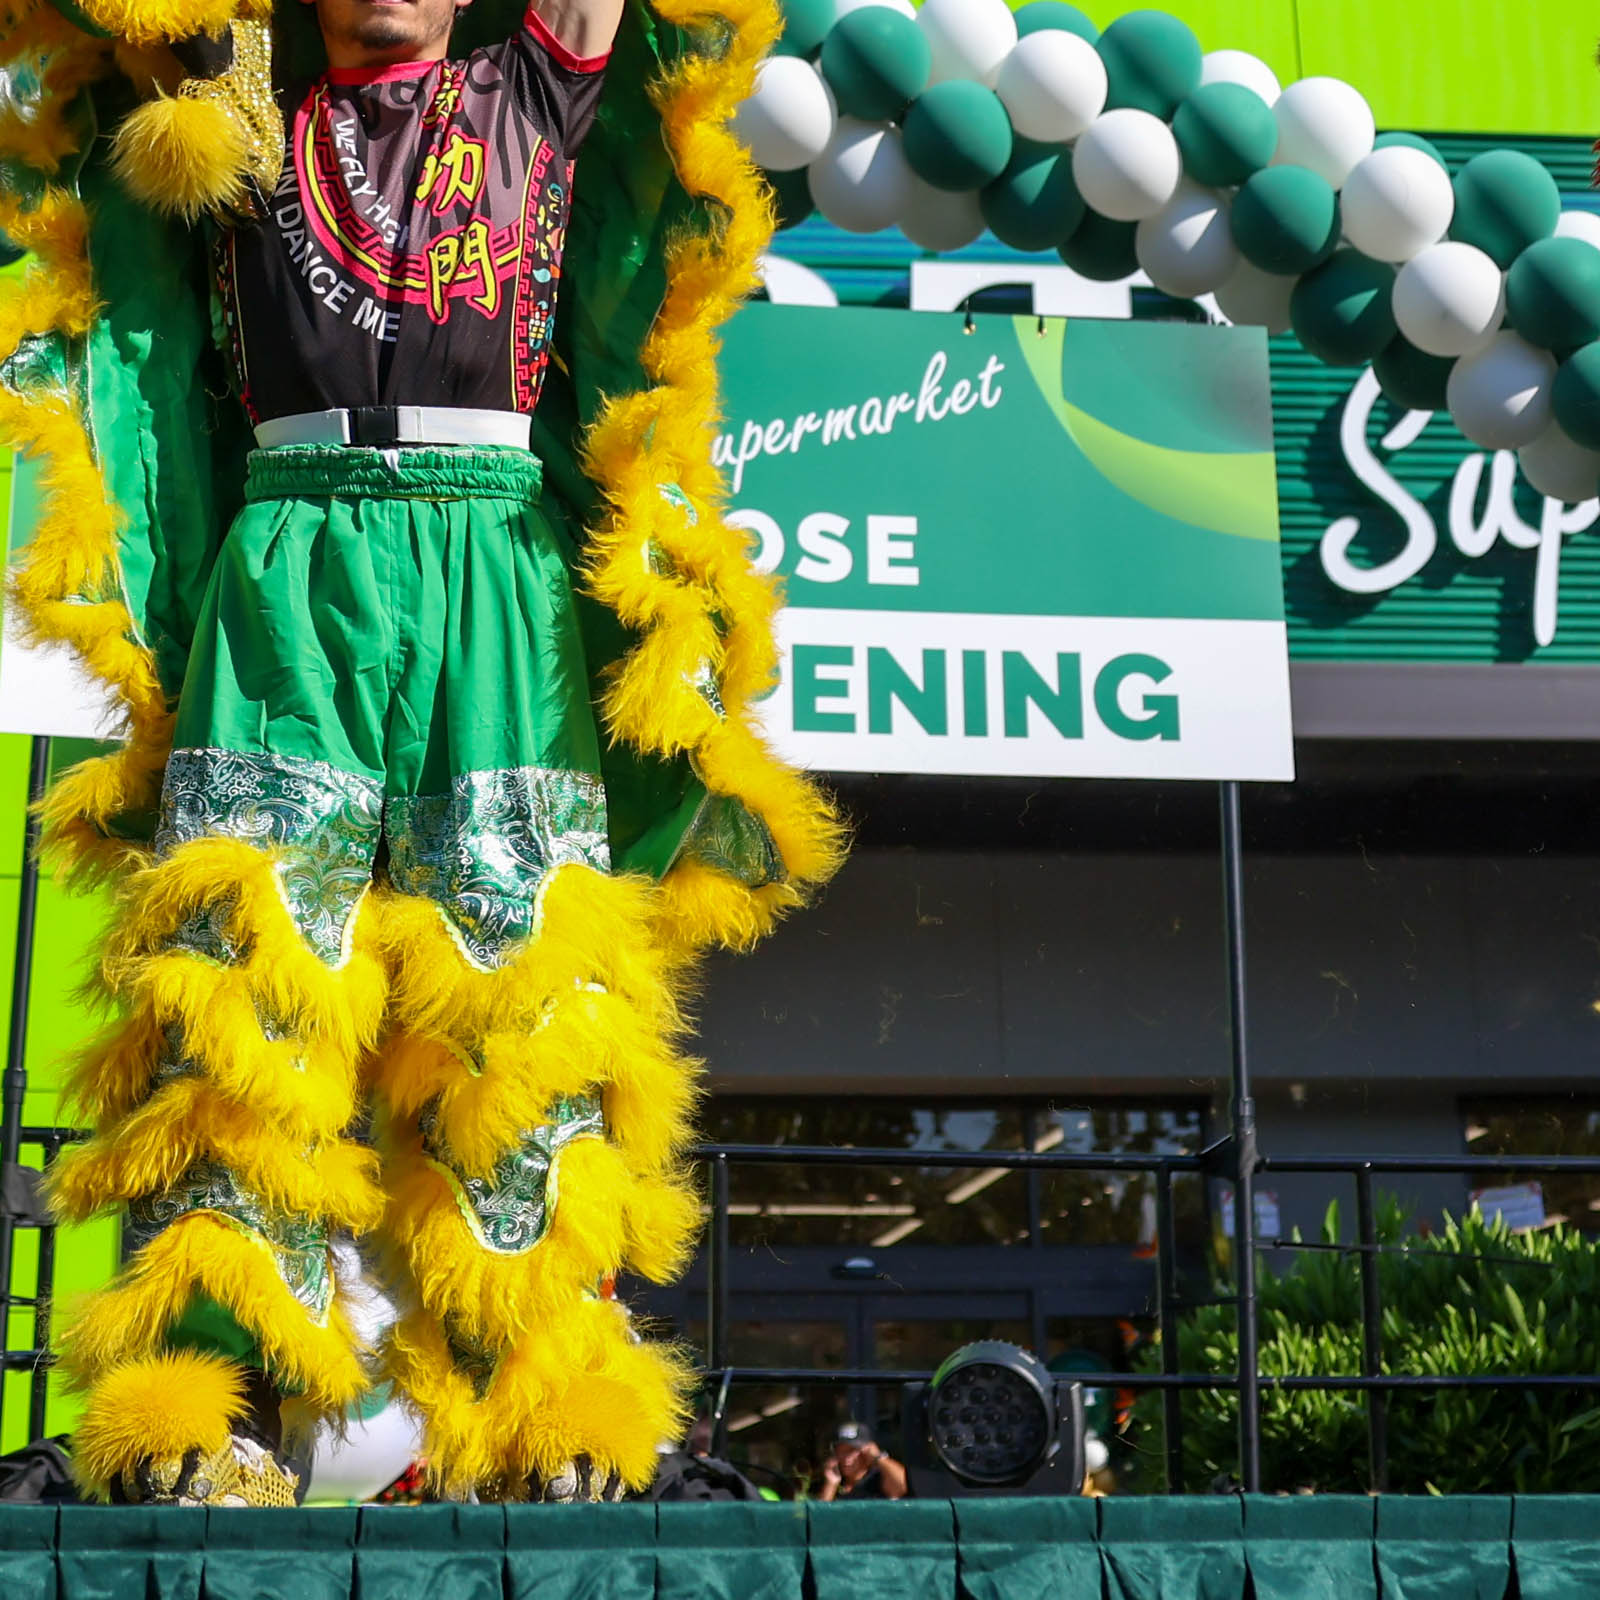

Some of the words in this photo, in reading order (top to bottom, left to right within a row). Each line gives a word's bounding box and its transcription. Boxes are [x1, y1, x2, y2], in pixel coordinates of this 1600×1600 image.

[335, 118, 357, 156] WE
[339, 157, 378, 196] FLY
[275, 202, 356, 314] DANCE
[352, 297, 401, 342] ME
[757, 643, 1181, 742] ENING
